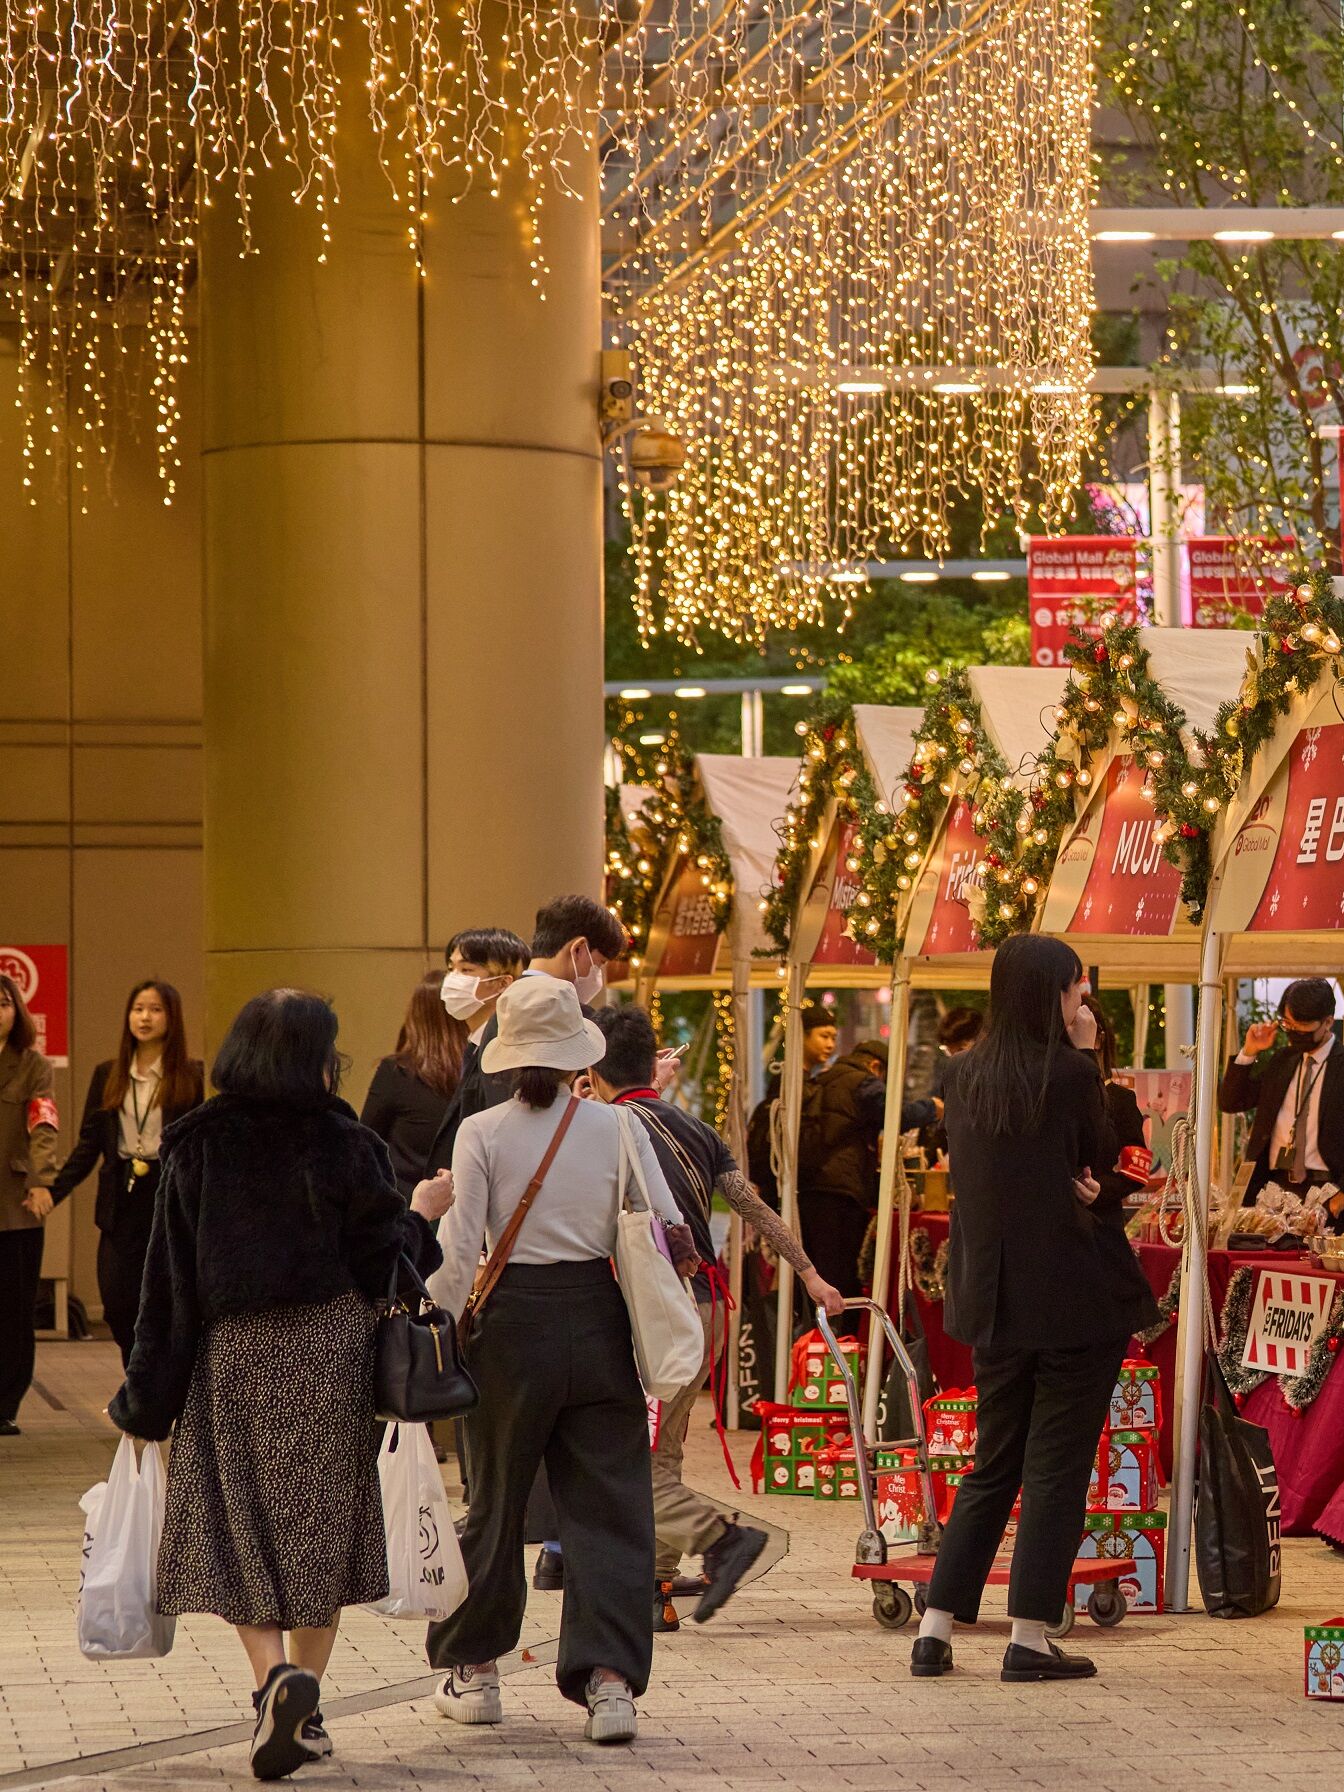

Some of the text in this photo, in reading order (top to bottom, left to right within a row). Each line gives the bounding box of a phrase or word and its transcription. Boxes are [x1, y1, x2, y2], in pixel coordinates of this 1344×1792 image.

[1111, 819, 1163, 875] MUJI
[1268, 1307, 1314, 1342] FRIDAYS
[1250, 1457, 1281, 1578] RENT
